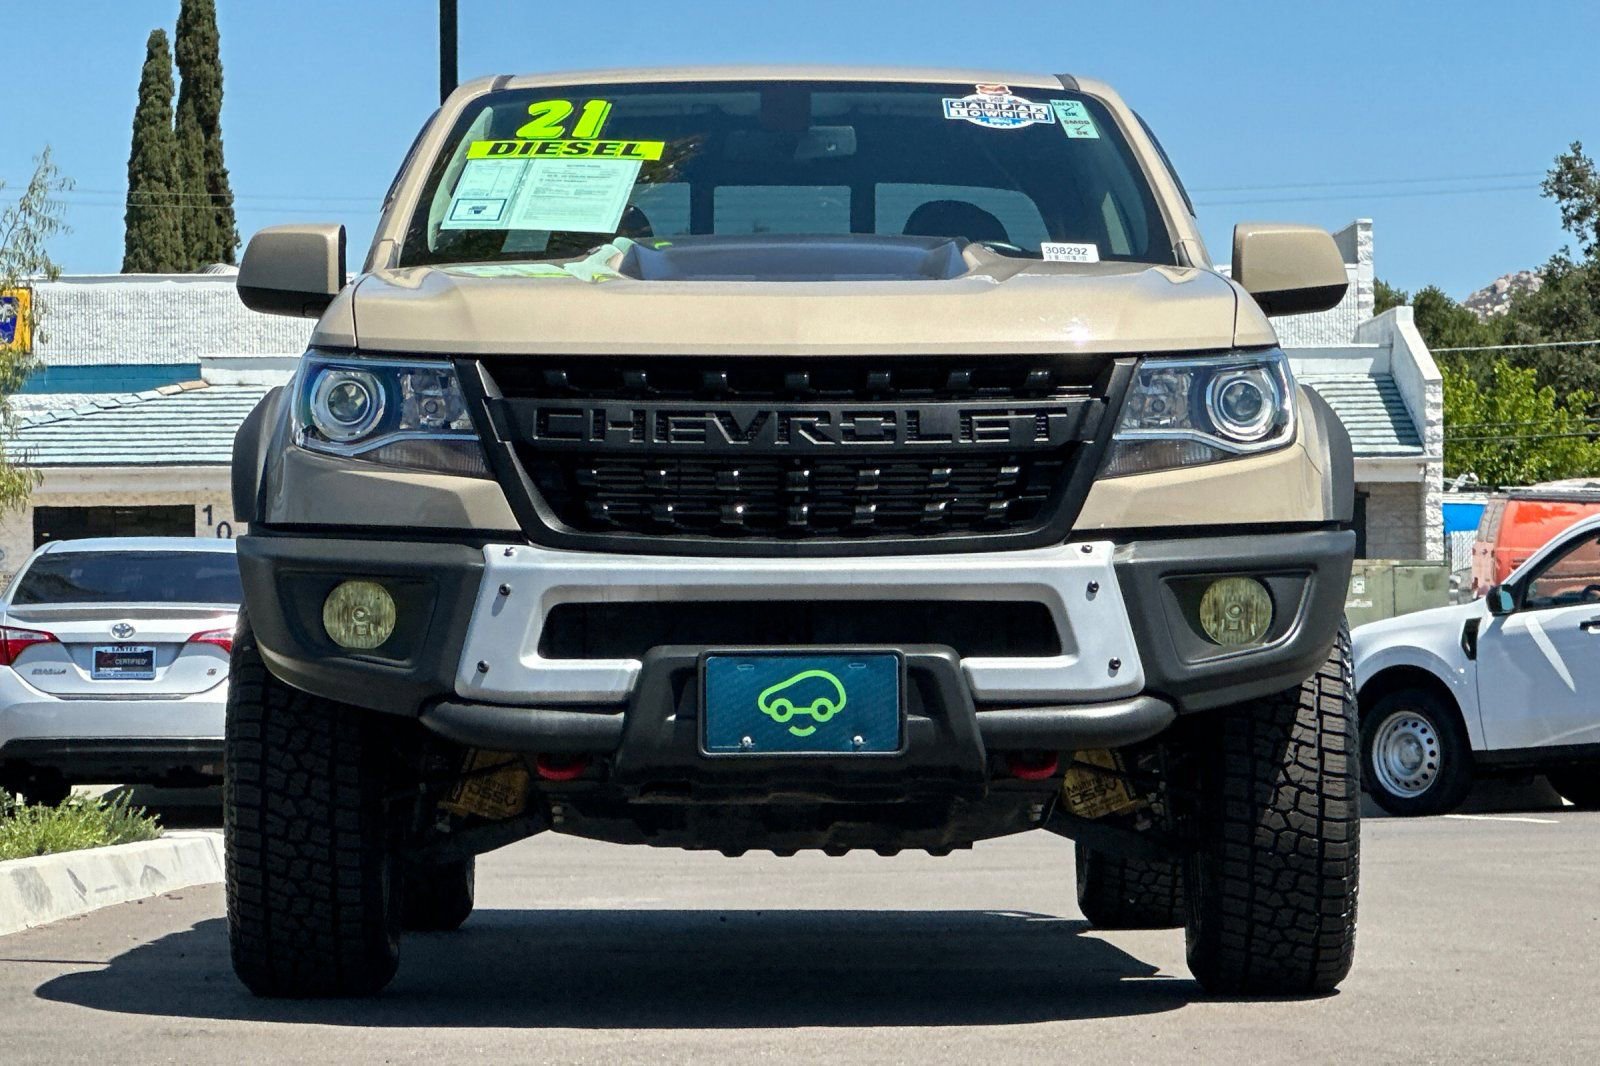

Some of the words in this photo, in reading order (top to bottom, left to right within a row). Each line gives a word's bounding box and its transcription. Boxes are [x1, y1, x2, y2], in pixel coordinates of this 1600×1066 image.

[951, 101, 1044, 113] CARFAX
[516, 99, 612, 139] 21
[968, 109, 1048, 120] OWNER
[487, 141, 646, 157] DIESEL
[1045, 246, 1088, 256] 308292
[533, 407, 1068, 445] CHEVROLET
